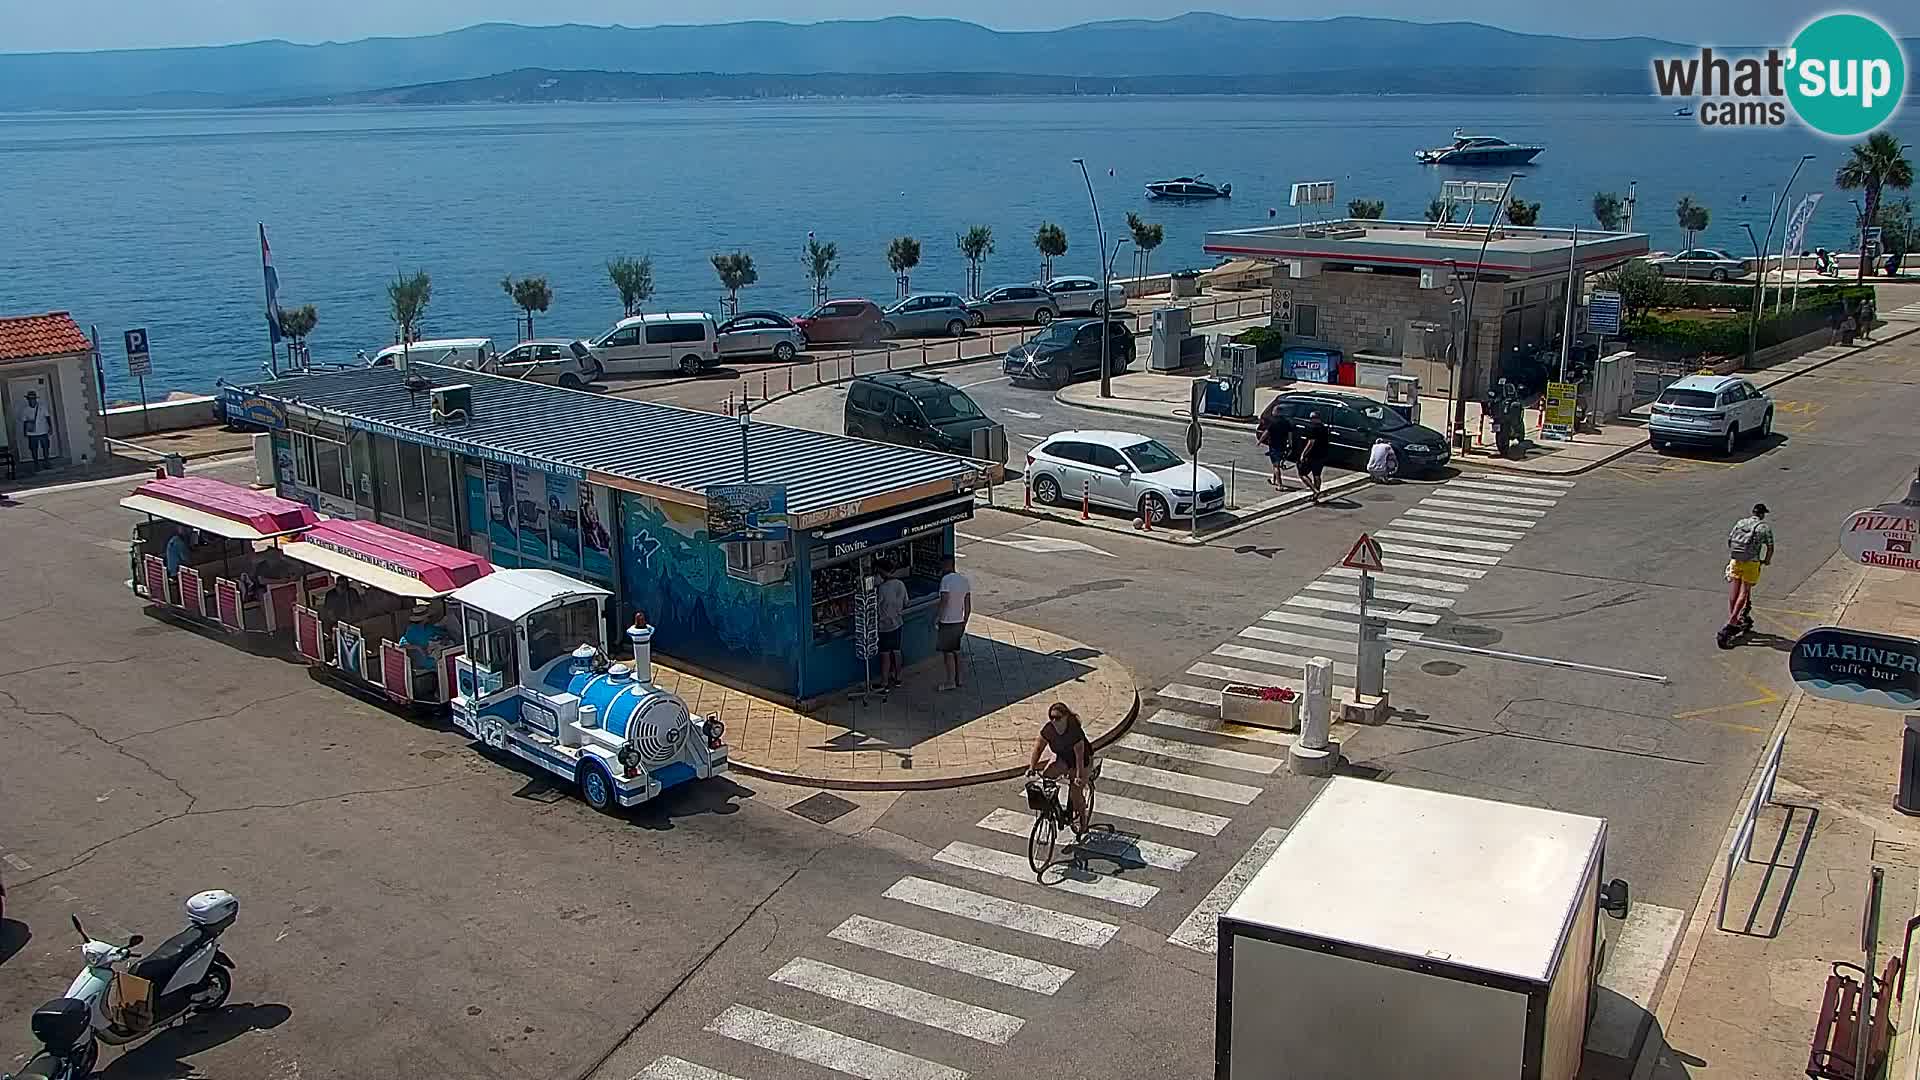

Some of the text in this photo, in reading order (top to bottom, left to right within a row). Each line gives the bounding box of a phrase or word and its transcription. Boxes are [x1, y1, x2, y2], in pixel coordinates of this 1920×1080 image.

[130, 333, 142, 350] P
[494, 450, 526, 467] STATION
[529, 459, 554, 473] TICKET
[555, 463, 583, 479] OFFICE
[1849, 516, 1920, 534] PIZZE
[399, 564, 419, 578] CENTER
[1801, 643, 1920, 672] MARINER
[1831, 663, 1899, 680] caffe bar
